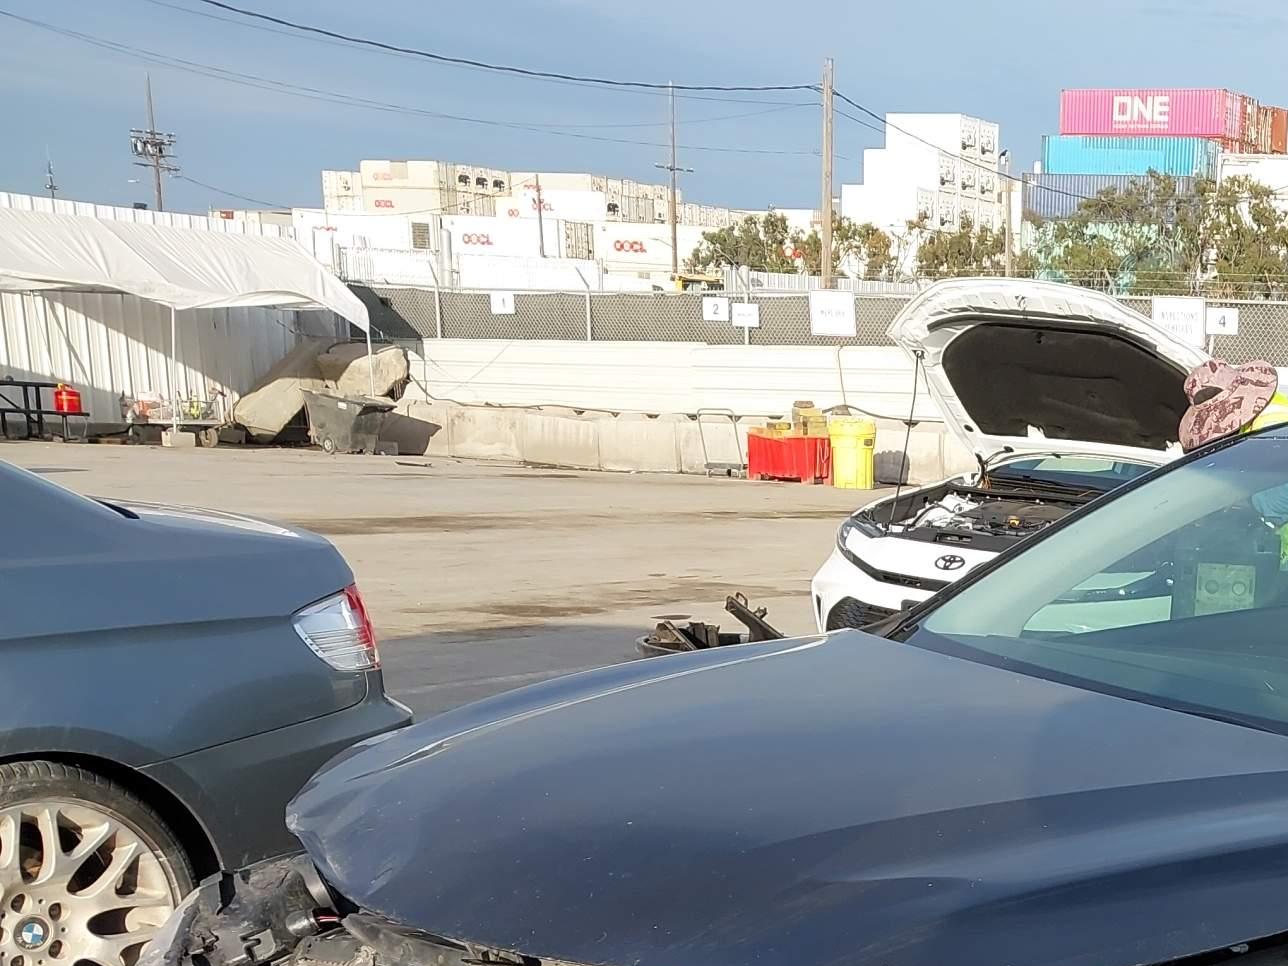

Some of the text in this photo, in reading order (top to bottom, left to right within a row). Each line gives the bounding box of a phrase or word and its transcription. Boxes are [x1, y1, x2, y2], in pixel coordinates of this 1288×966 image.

[1112, 95, 1170, 121] ONE
[462, 232, 494, 246] OOCL
[613, 240, 647, 253] OOCL
[712, 303, 720, 315] 2
[1218, 315, 1227, 328] 4
